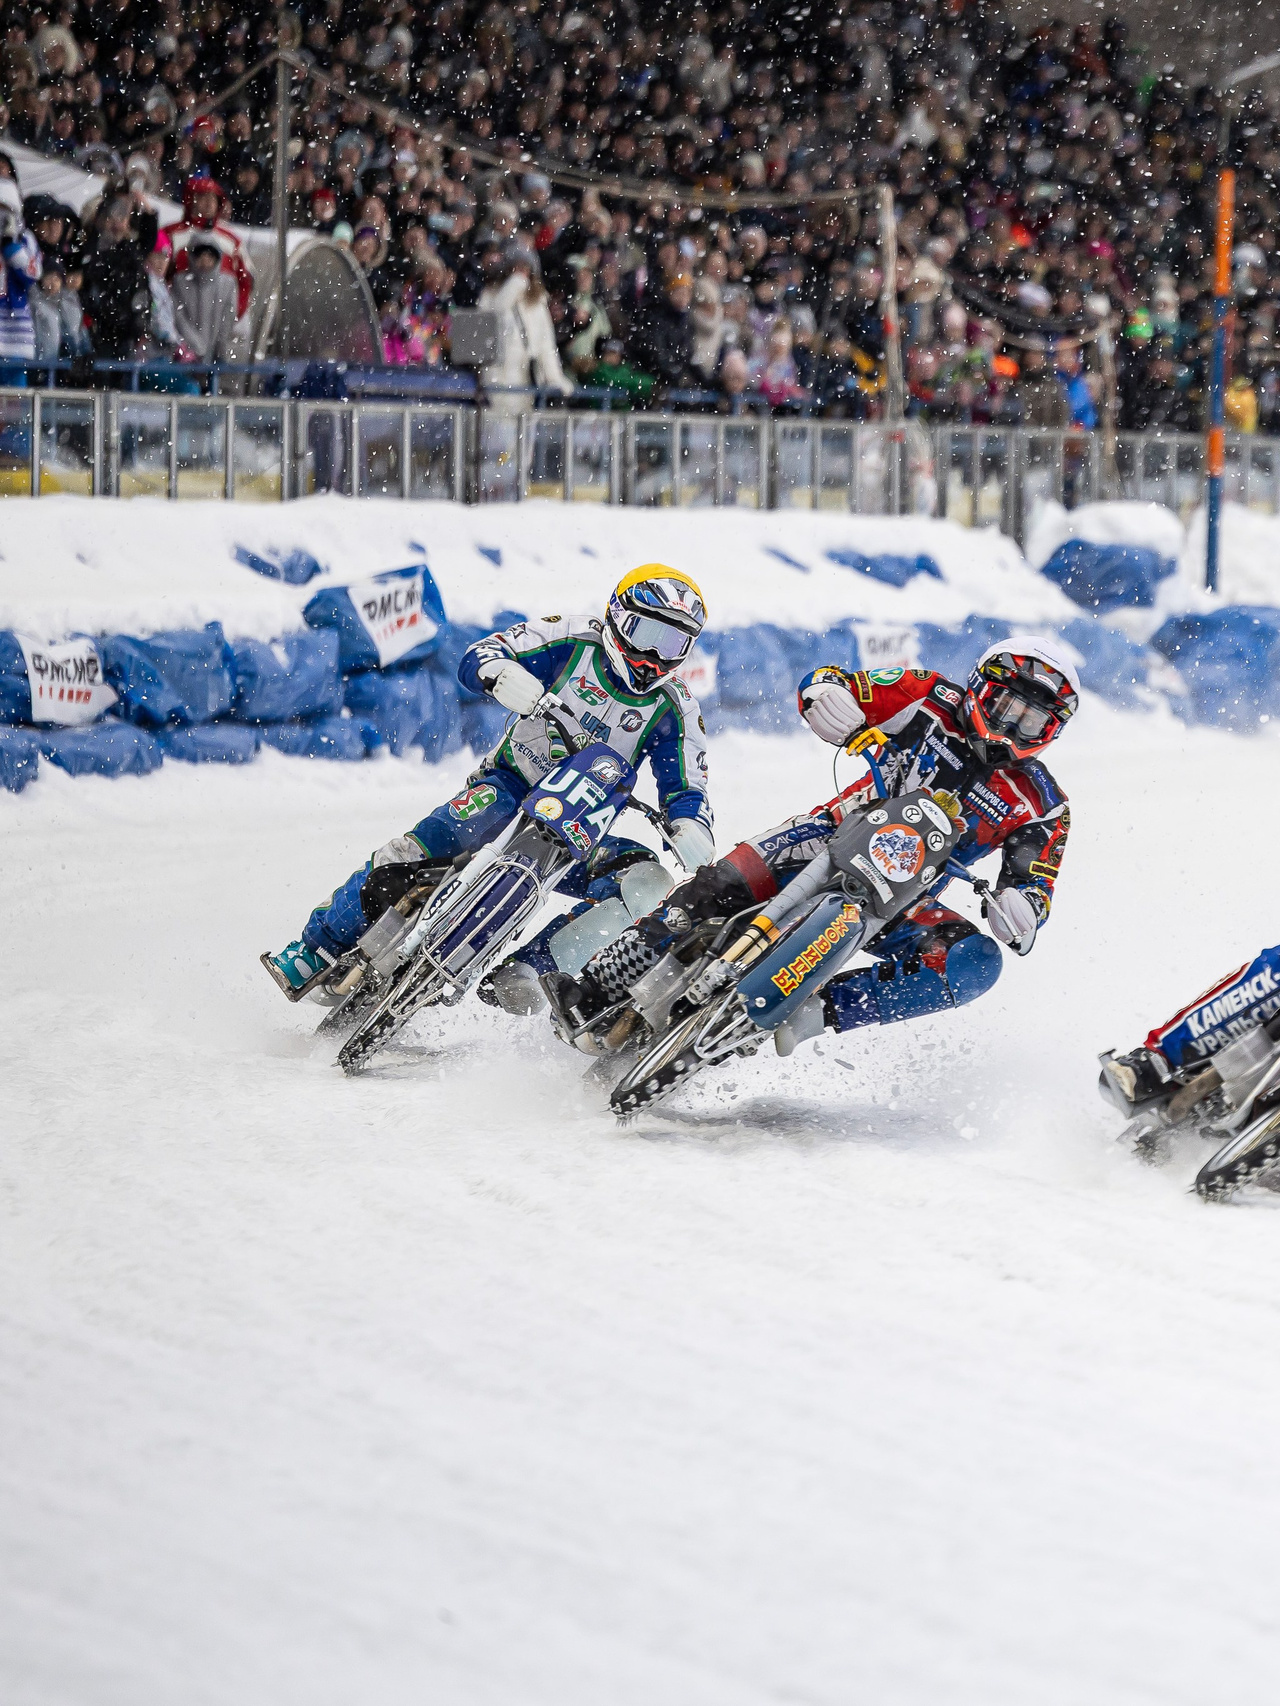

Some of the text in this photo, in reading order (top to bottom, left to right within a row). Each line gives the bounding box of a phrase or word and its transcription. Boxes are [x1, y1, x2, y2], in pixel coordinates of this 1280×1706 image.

[580, 711, 612, 743] UFA
[538, 766, 617, 843] UFA
[964, 792, 1005, 829] RUSSIA
[972, 781, 1003, 809] МАКАРОВ
[871, 846, 897, 875] МЧС
